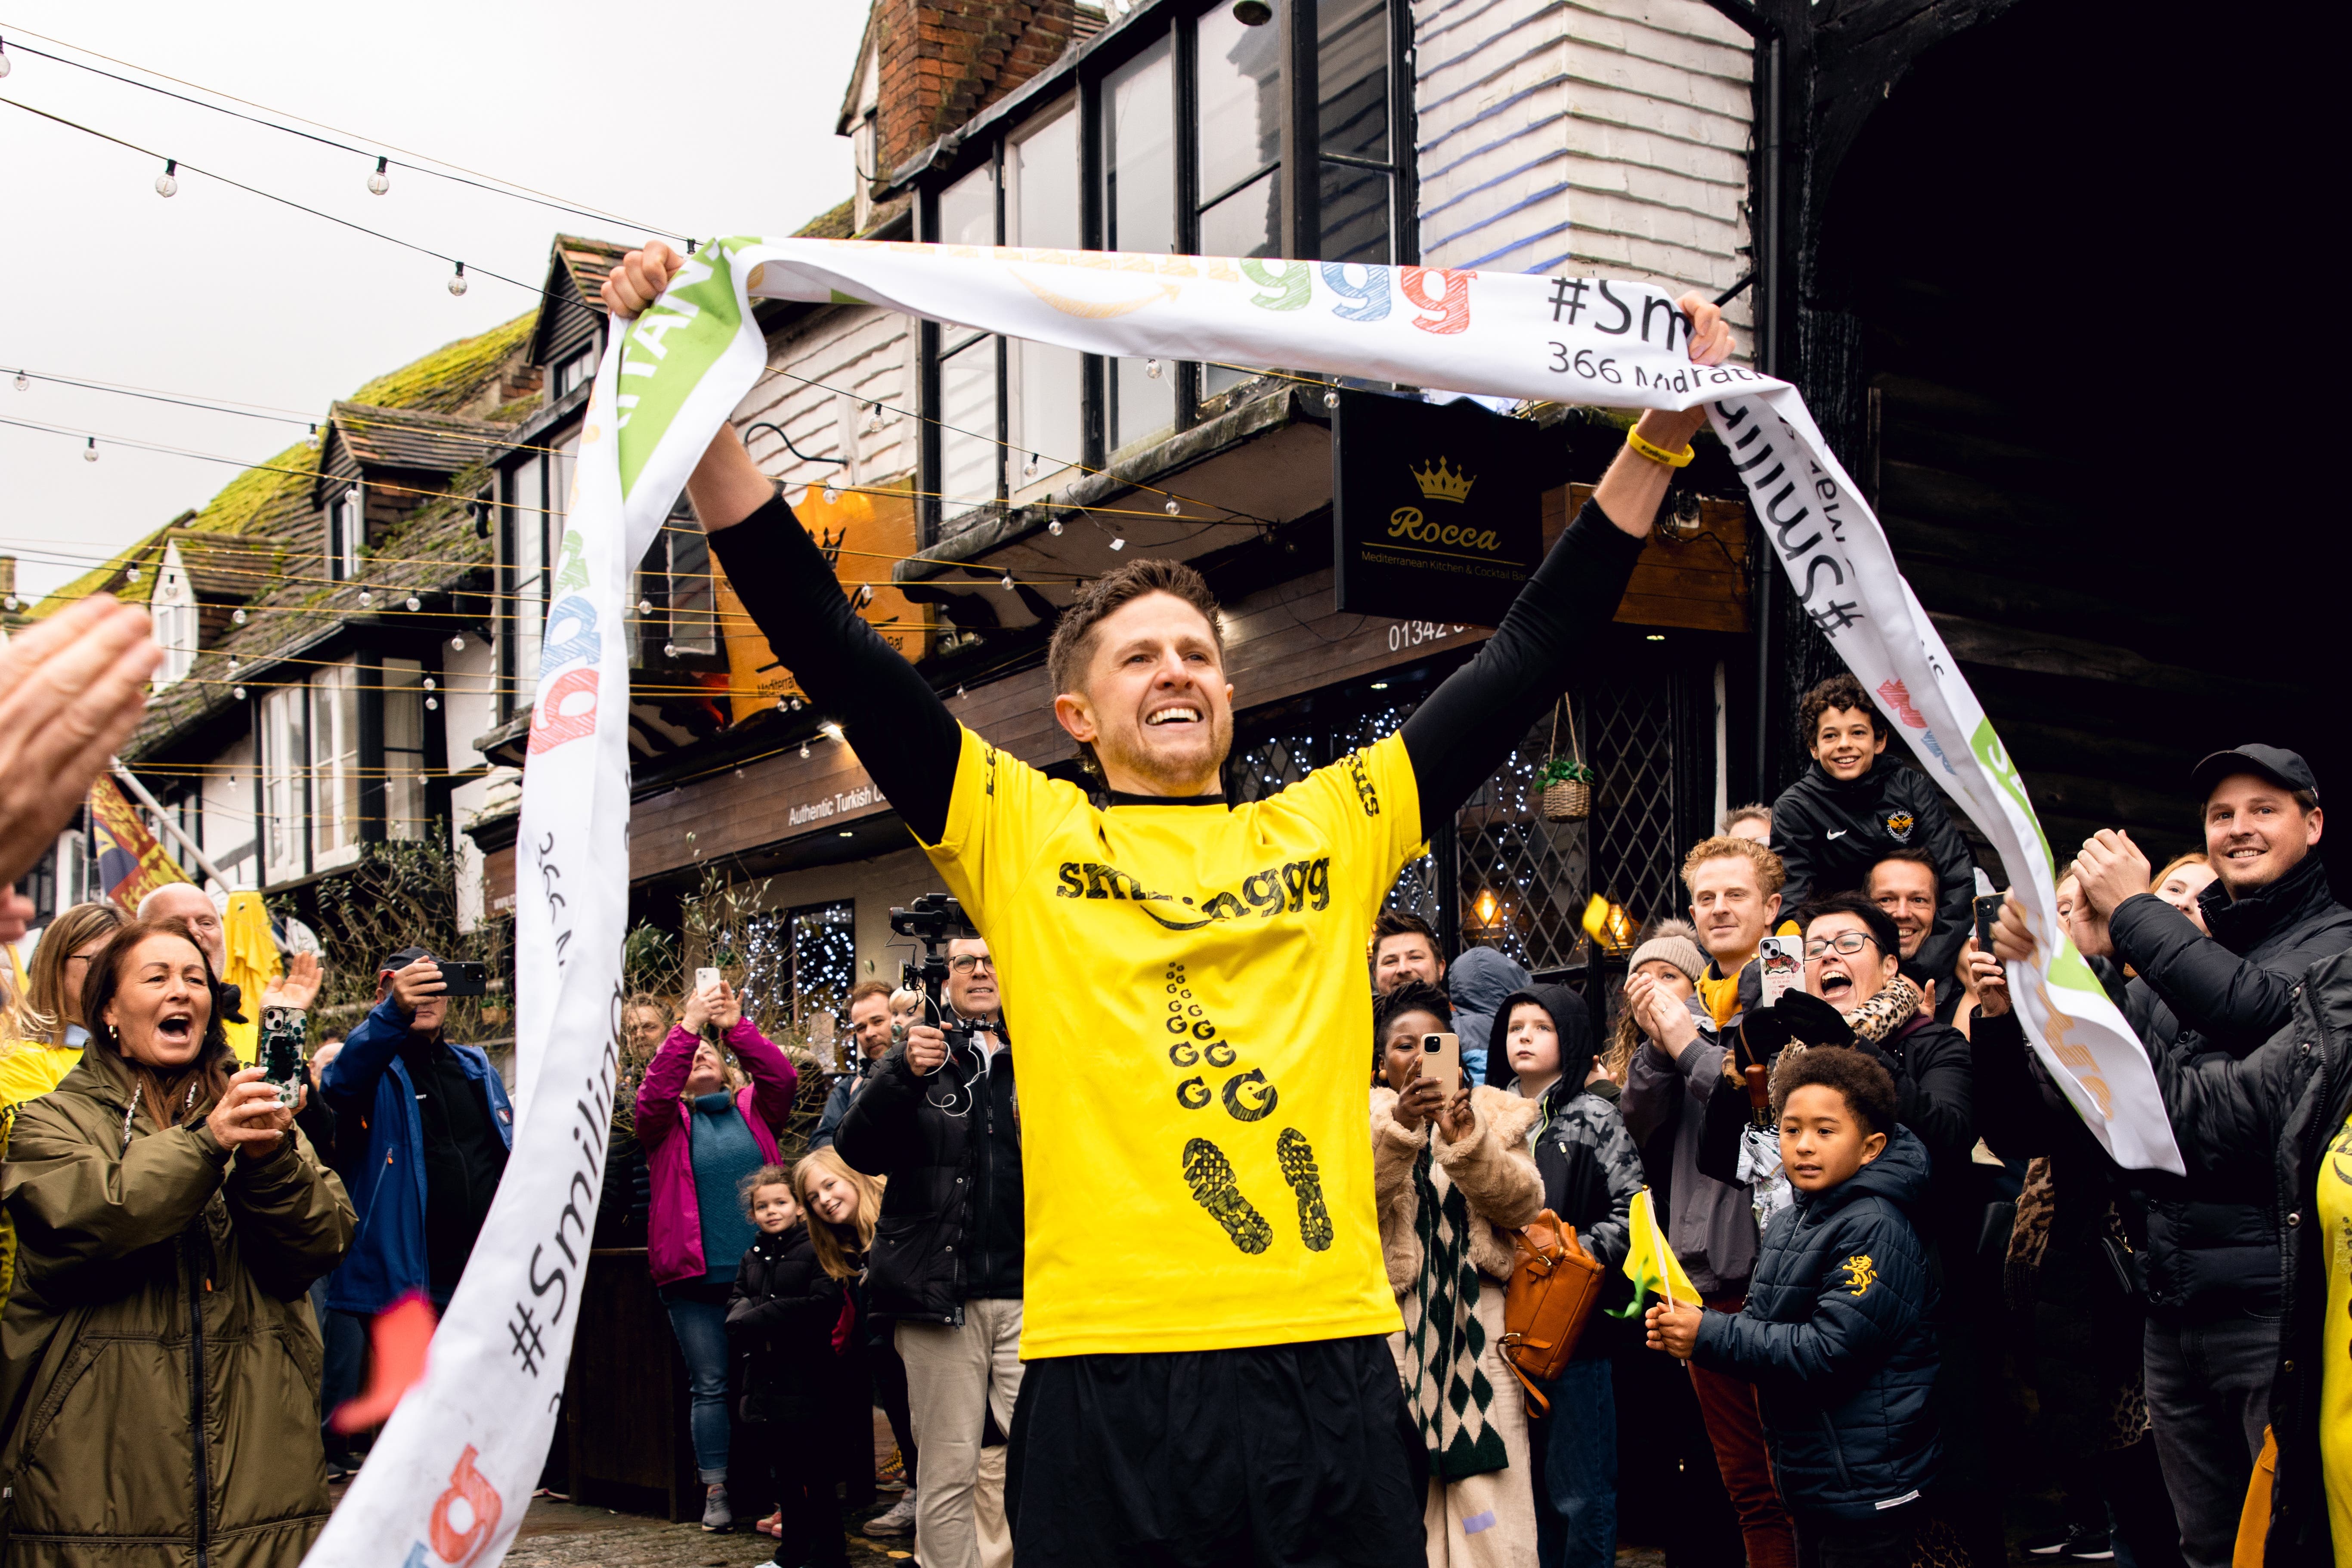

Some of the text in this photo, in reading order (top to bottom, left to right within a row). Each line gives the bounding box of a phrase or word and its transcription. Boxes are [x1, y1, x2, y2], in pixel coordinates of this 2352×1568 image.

[1548, 341, 1622, 384] 366
[1387, 506, 1501, 551] Rocca
[1362, 551, 1527, 581] Mediterranean Kitchen & Cocktail Bar
[1389, 620, 1447, 651] 01342
[789, 798, 834, 826] Authentic
[834, 786, 872, 813] Turkish
